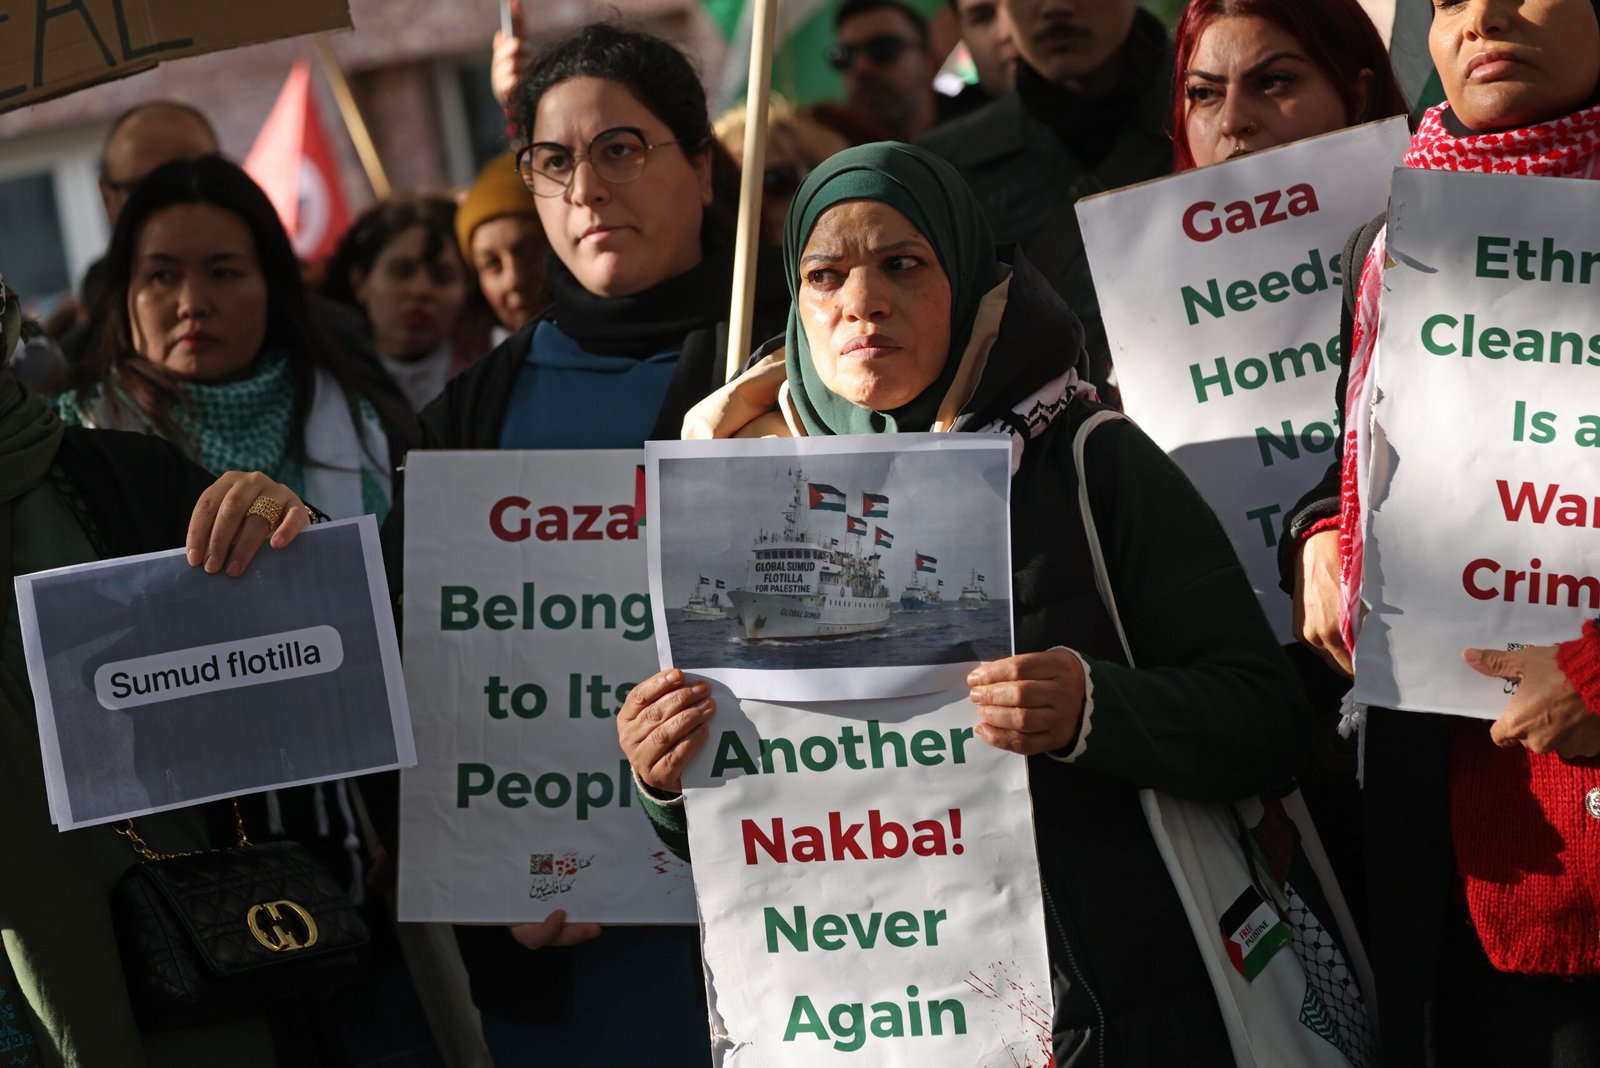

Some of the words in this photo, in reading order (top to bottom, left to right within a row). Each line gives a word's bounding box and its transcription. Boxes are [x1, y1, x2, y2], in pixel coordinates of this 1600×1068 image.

[0, 0, 194, 99] AL
[1181, 182, 1320, 242] Gaza
[1512, 400, 1557, 444] Is
[1574, 414, 1600, 448] a
[488, 495, 639, 542] Gaza
[755, 561, 786, 572] GLOBAL
[786, 561, 816, 572] SUMUD
[755, 584, 769, 593] FOR
[769, 584, 811, 593] PALESTINE
[763, 573, 804, 583] FLOTILLA
[441, 582, 655, 641] Belong
[110, 655, 221, 699] Sumud
[226, 641, 322, 678] flotilla
[484, 676, 548, 720] to
[710, 720, 975, 778] Another
[741, 808, 965, 865] Nakba!
[763, 905, 947, 953] Never
[782, 984, 967, 1052] Again
